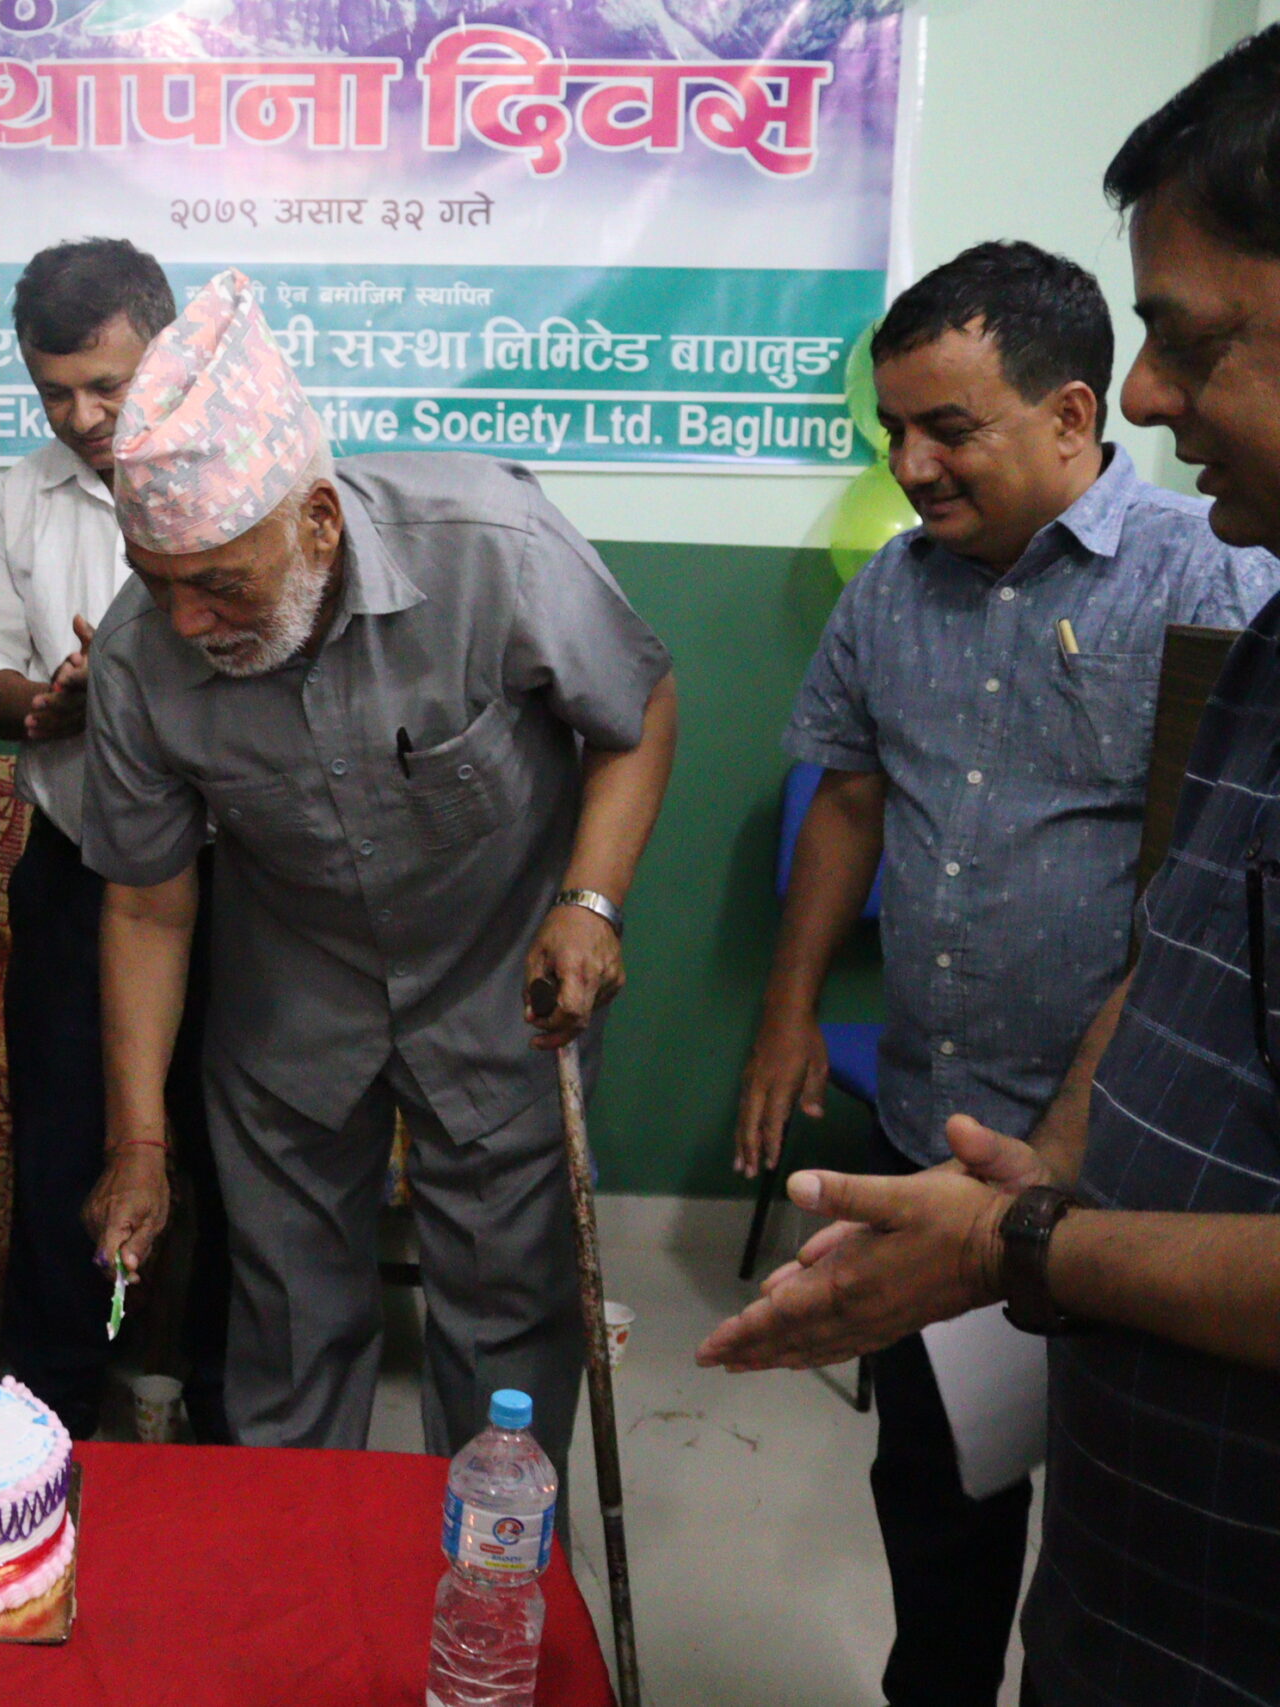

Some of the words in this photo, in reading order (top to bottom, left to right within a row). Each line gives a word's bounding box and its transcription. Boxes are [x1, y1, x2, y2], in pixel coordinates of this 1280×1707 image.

[418, 24, 831, 177] दिवस
[170, 199, 258, 229] २०७९
[275, 198, 368, 224] असार
[381, 200, 424, 229] ३२
[439, 192, 494, 226] गते
[277, 281, 309, 309] ऐन
[319, 280, 405, 305] बमोजिम
[416, 281, 493, 306] स्थापित
[270, 314, 319, 368] री
[328, 321, 471, 373] संस्था
[481, 316, 661, 373] लिमिटेड
[669, 335, 844, 388] बागलुङ
[321, 399, 399, 441] tive
[412, 399, 570, 453] Society
[584, 402, 662, 445] Ltd.
[678, 404, 854, 456] Baglung
